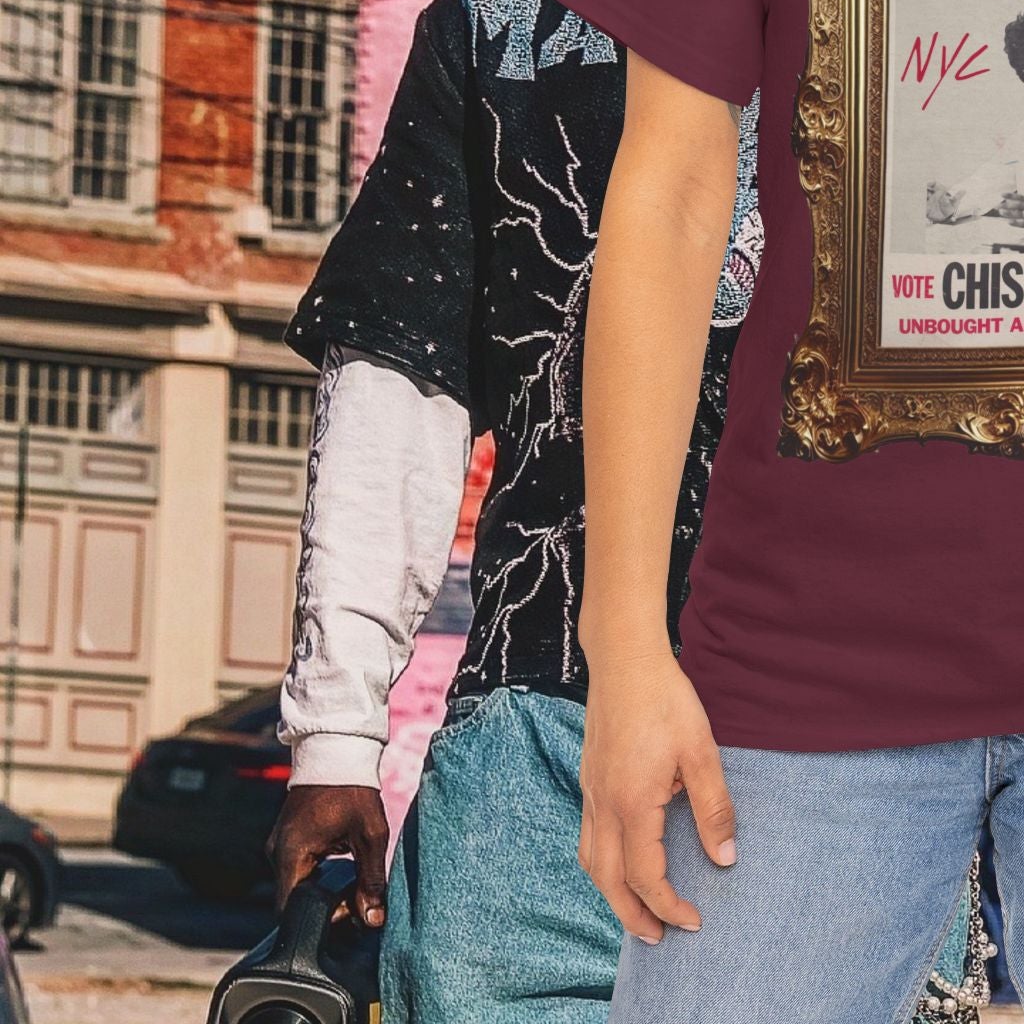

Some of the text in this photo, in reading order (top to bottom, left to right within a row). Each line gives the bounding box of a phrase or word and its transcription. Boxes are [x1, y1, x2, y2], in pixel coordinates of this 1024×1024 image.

[901, 31, 991, 111] NYC
[892, 274, 934, 299] VOTE
[899, 317, 1004, 334] UNBOUGHT
